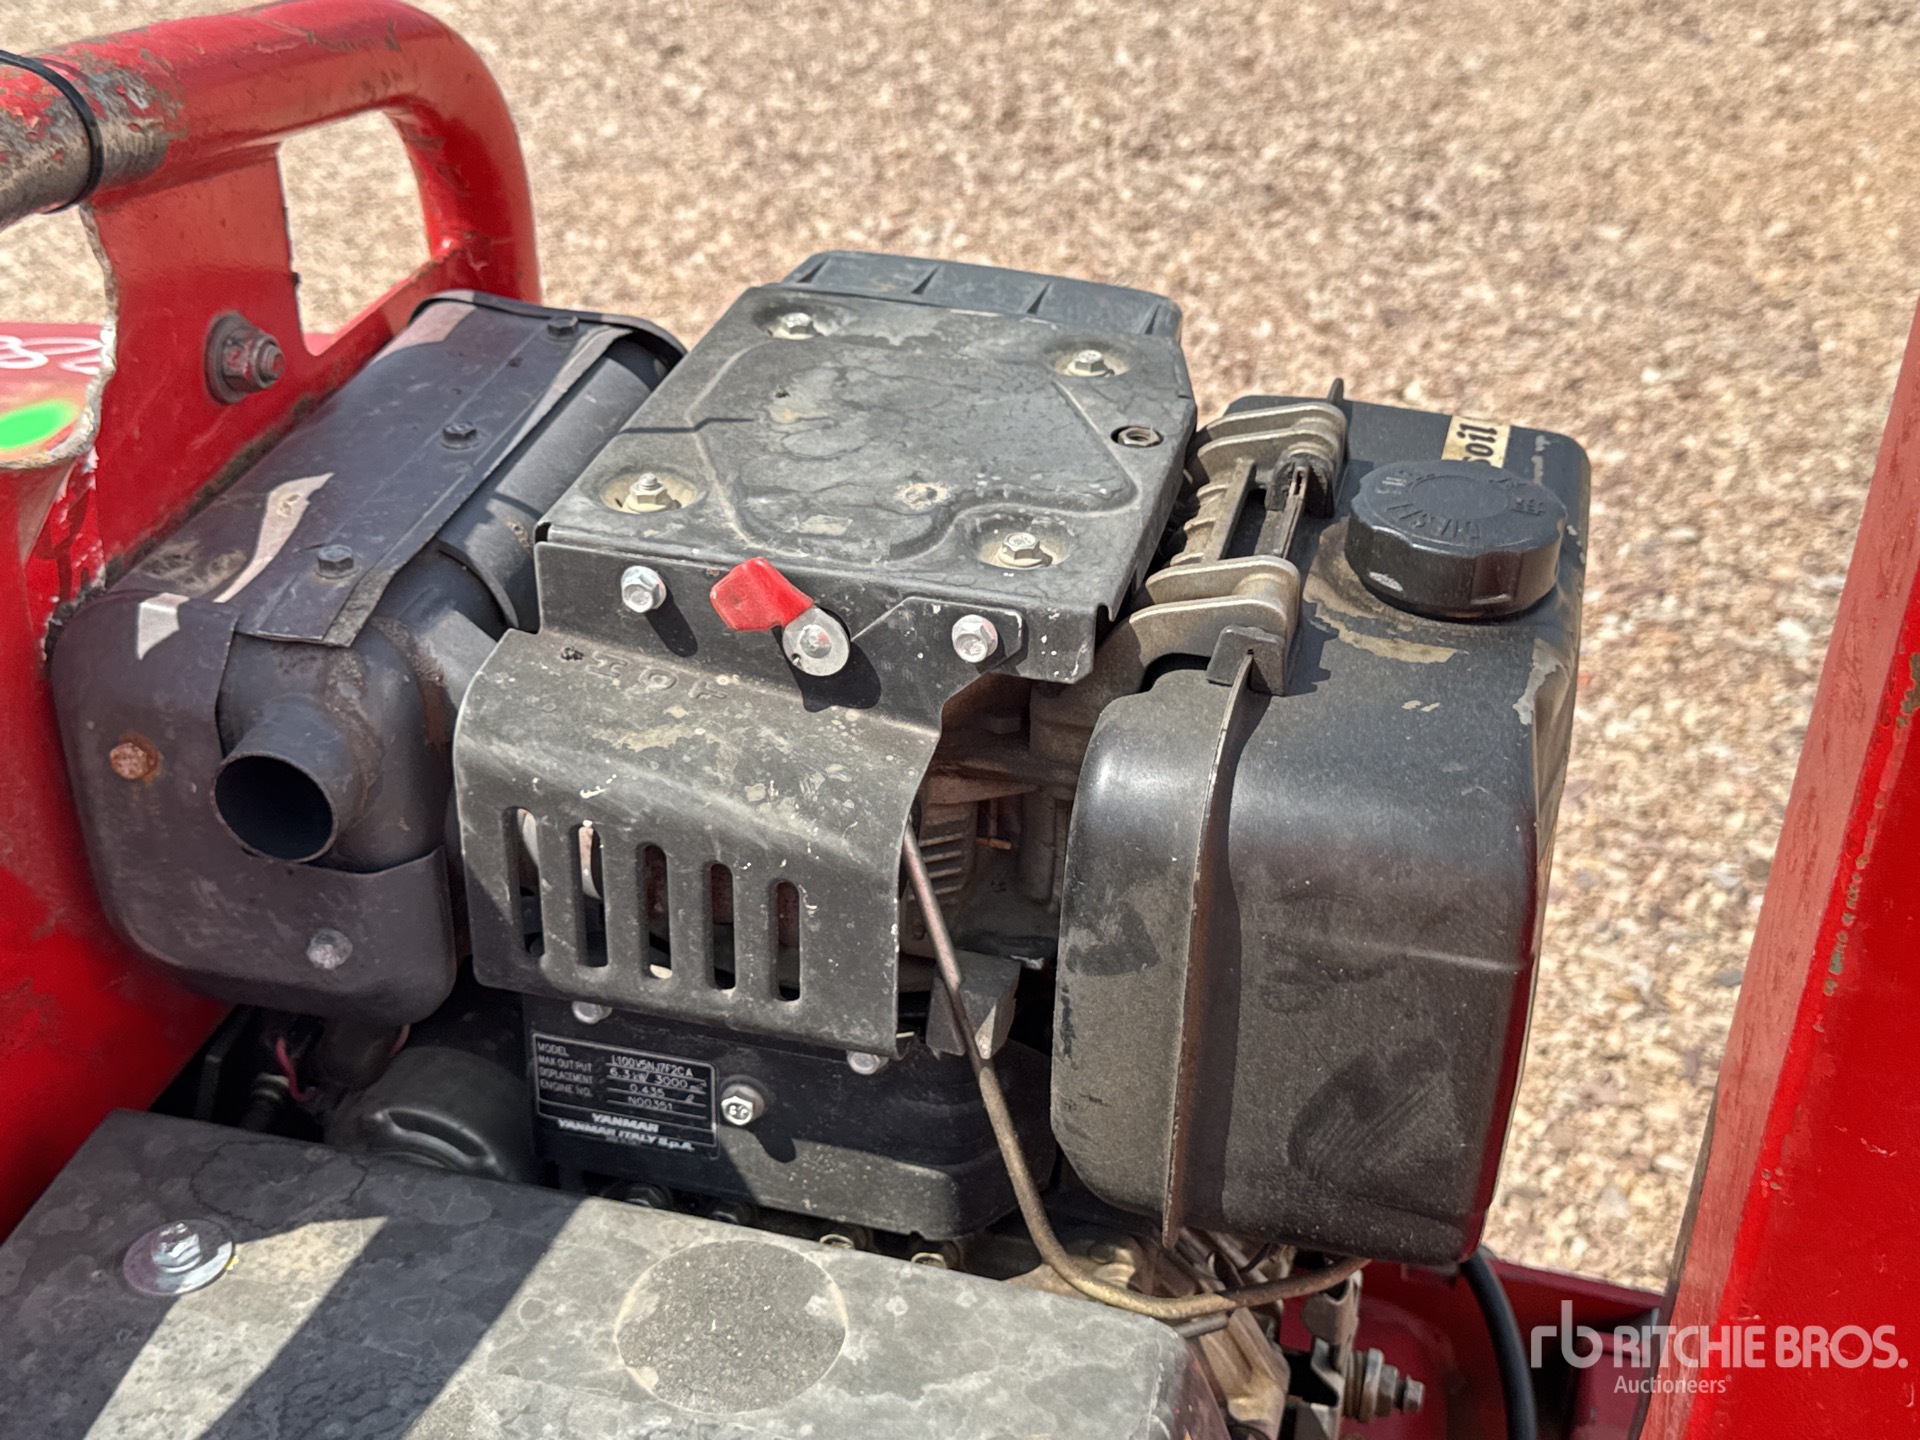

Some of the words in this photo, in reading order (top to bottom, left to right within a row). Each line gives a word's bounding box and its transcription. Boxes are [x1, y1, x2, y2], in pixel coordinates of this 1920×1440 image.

[1456, 423, 1498, 467] oil
[557, 1118, 616, 1137] YANMAR
[617, 1130, 658, 1144] ITALY
[591, 1112, 660, 1133] YANMAR
